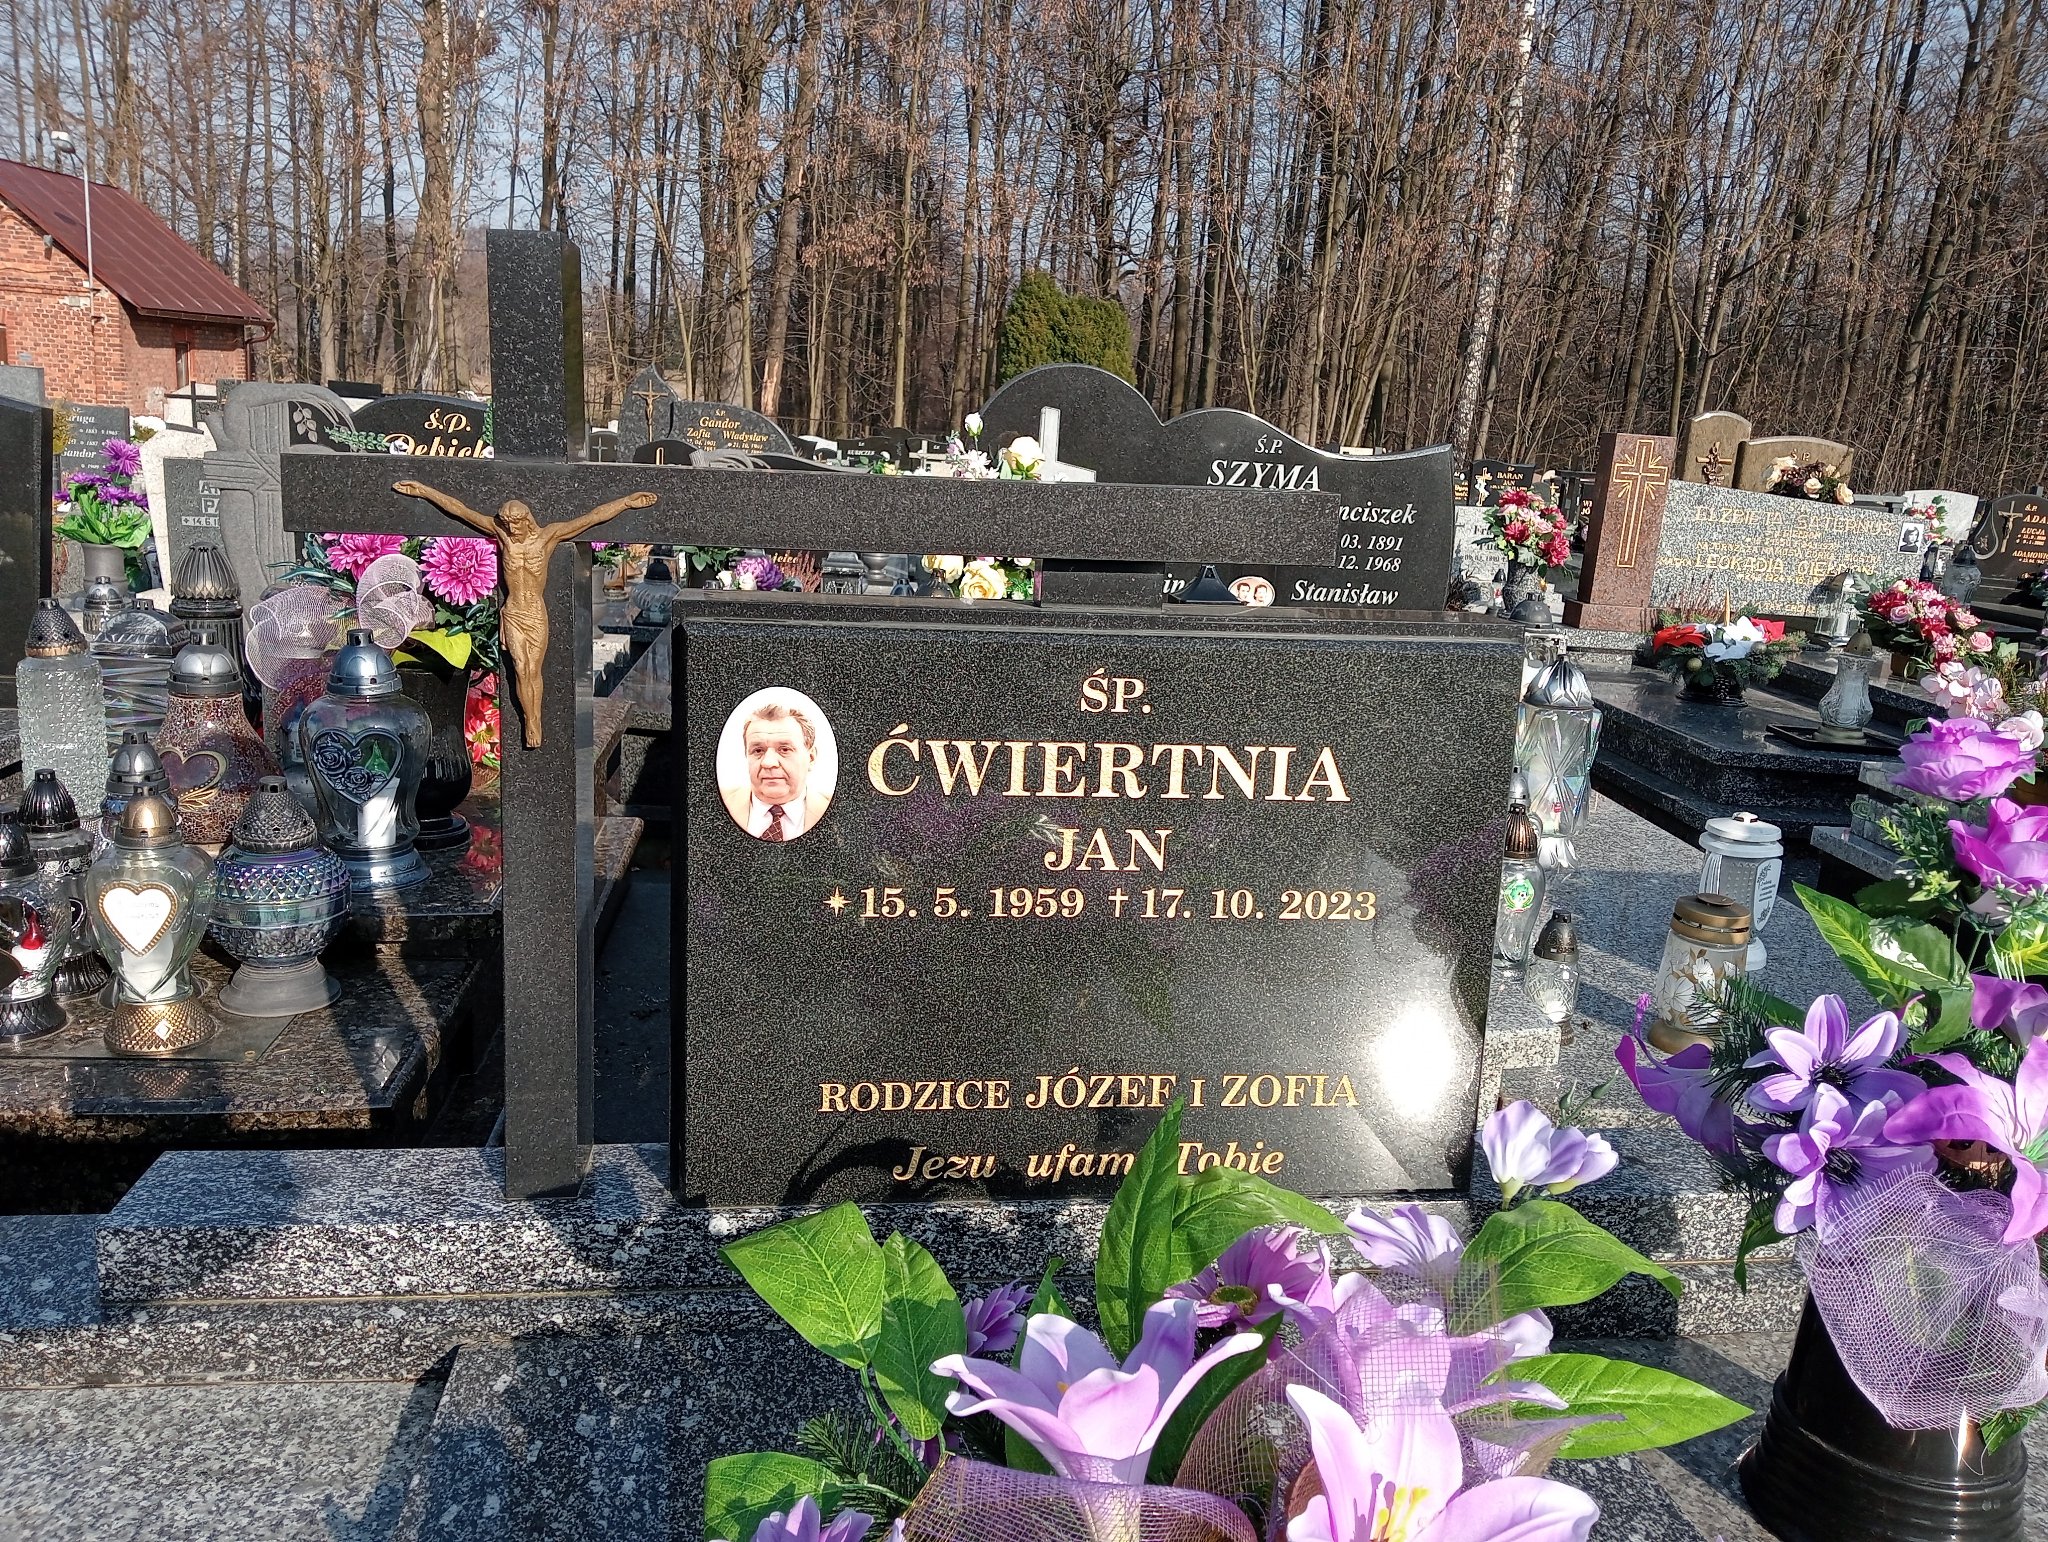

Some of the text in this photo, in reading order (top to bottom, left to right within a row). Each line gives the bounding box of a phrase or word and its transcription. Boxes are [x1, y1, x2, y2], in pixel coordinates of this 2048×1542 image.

[424, 408, 471, 433] Ś.P.
[699, 416, 740, 430] Gandor
[686, 427, 711, 439] Zofia
[1255, 434, 1283, 454] Ś.P.
[1207, 459, 1320, 492] SZYMA
[1497, 472, 1523, 480] BARAN
[203, 499, 220, 513] P
[1338, 501, 1417, 525] nciszek
[2023, 514, 2048, 525] ADA
[1367, 536, 1404, 551] 1891
[1365, 557, 1402, 572] 1968
[1162, 573, 1186, 594] in
[1291, 579, 1399, 605] Stanisław
[1080, 668, 1152, 713] ŚP.
[867, 724, 1350, 802] ĆWIERTNIA
[1044, 827, 1173, 871] JAN
[860, 888, 917, 918] 15.
[933, 888, 969, 918] 5.
[989, 887, 1085, 918] 1959
[1210, 889, 1263, 919] 10.
[1280, 890, 1377, 921] 2023
[818, 1081, 1010, 1112] RODZICE
[1025, 1066, 1177, 1109] JÓZEF
[1221, 1074, 1359, 1108] ZOFIA
[893, 1141, 1284, 1184] Jezu ufam Tobie
